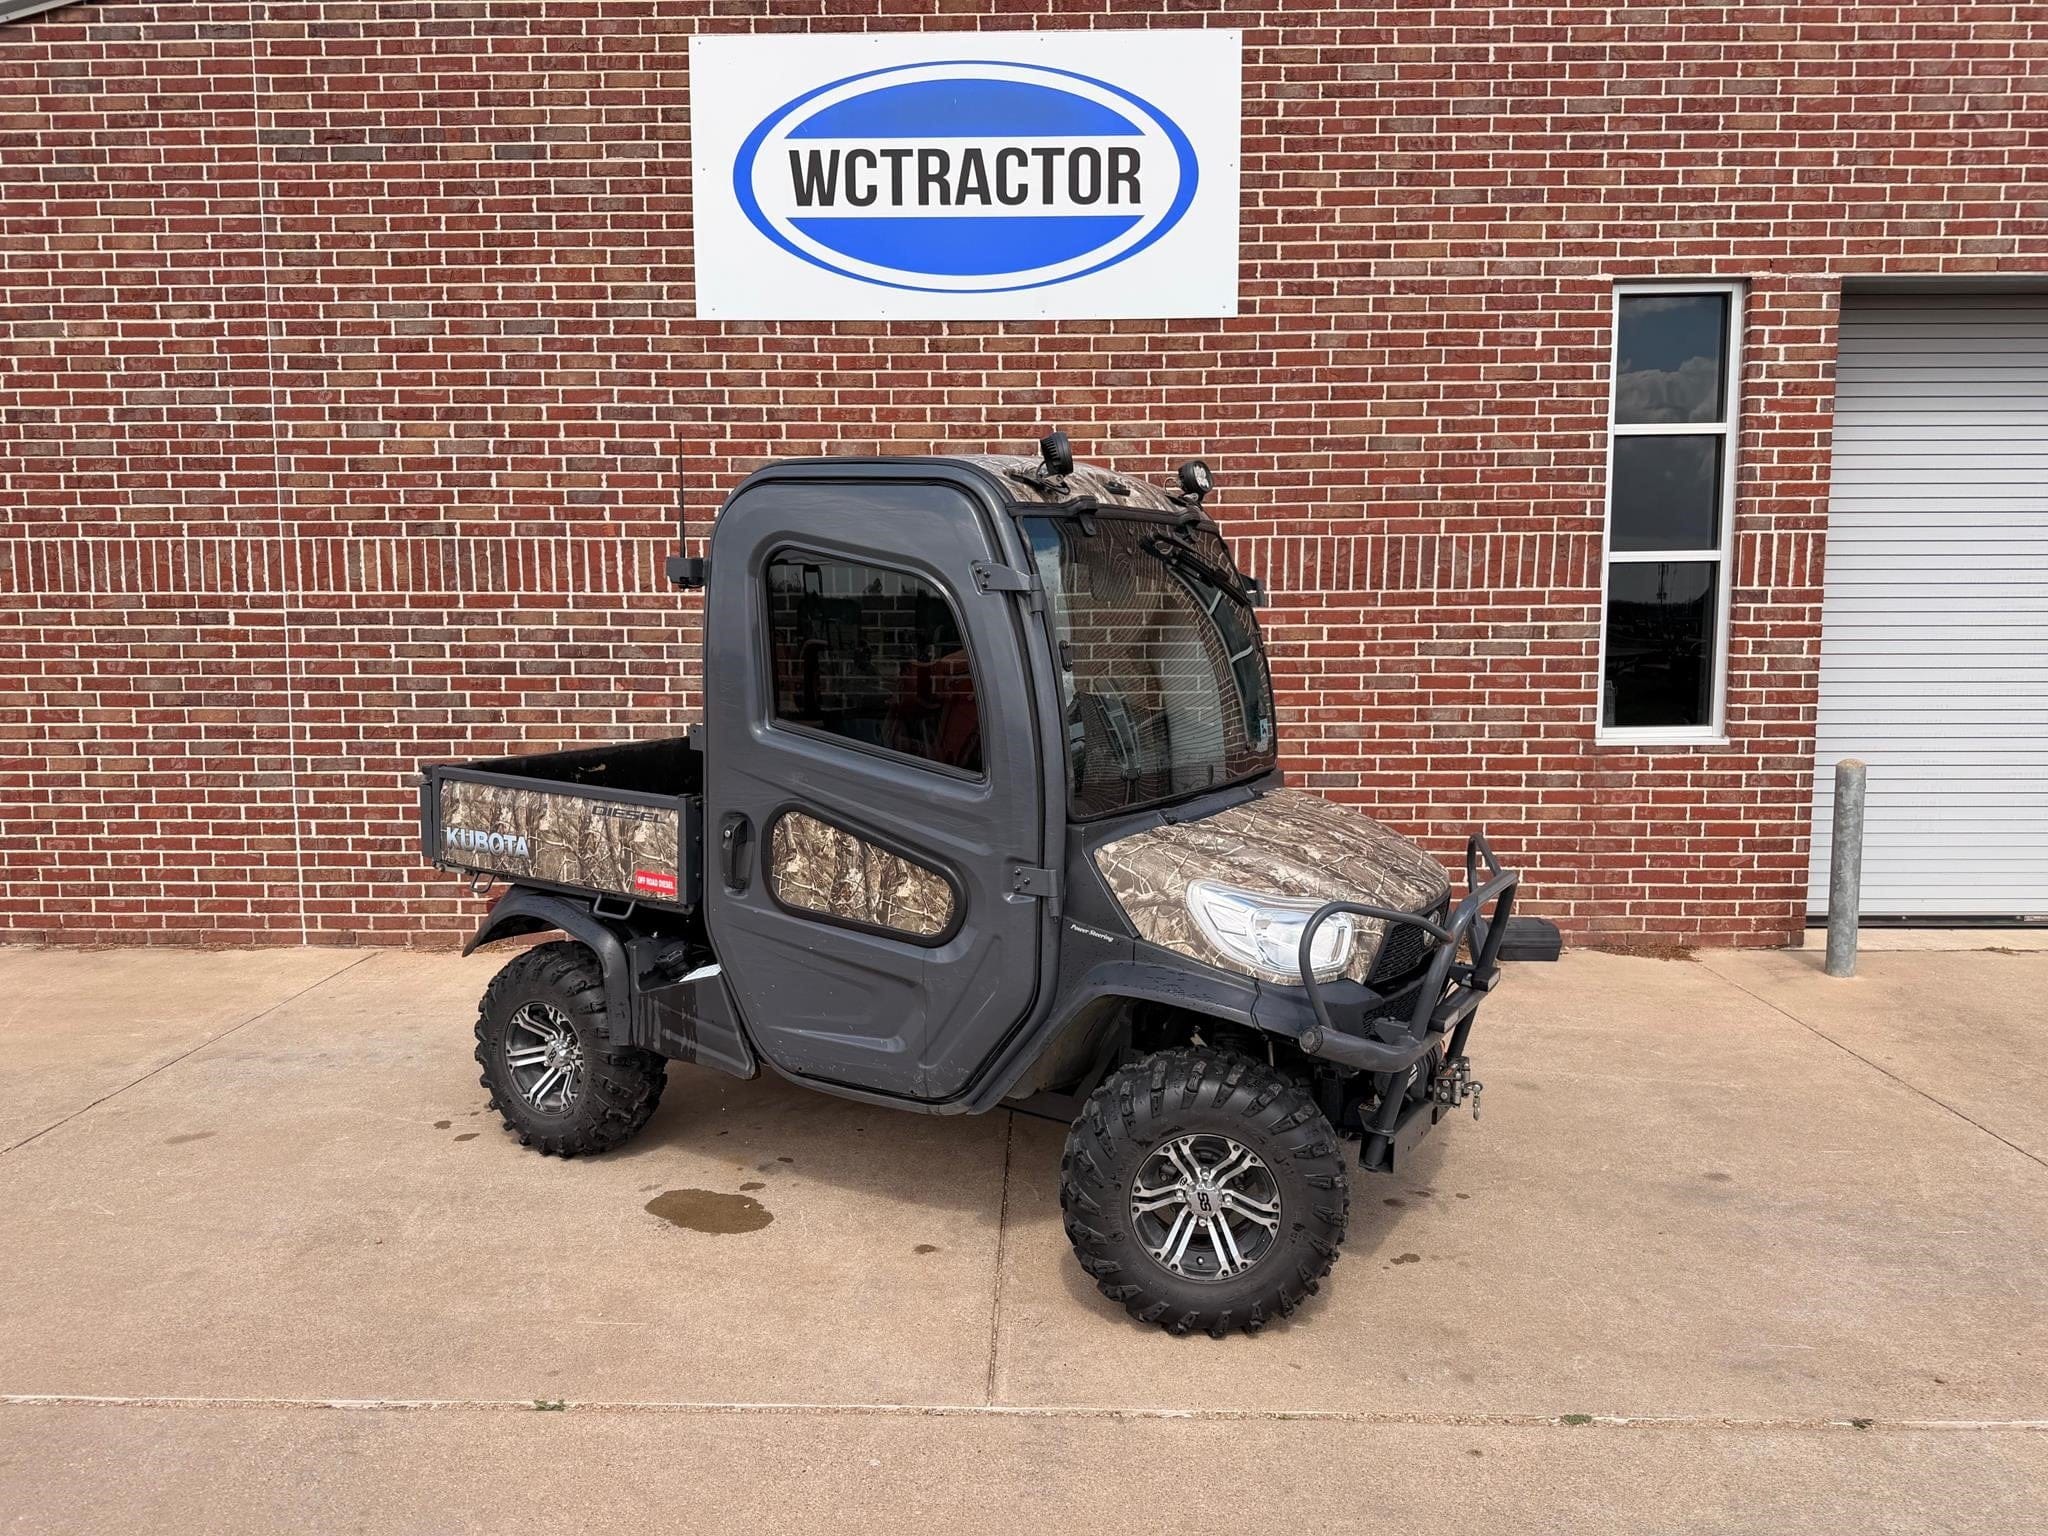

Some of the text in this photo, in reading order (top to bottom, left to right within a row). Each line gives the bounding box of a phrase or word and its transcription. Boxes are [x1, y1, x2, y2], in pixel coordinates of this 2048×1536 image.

[789, 147, 1141, 207] WCTRACTOR
[592, 805, 667, 824] DIESEL
[446, 826, 530, 859] KUBOTA
[637, 876, 674, 889] OFF ROAD DIESEL
[1070, 924, 1114, 942] Power Steering
